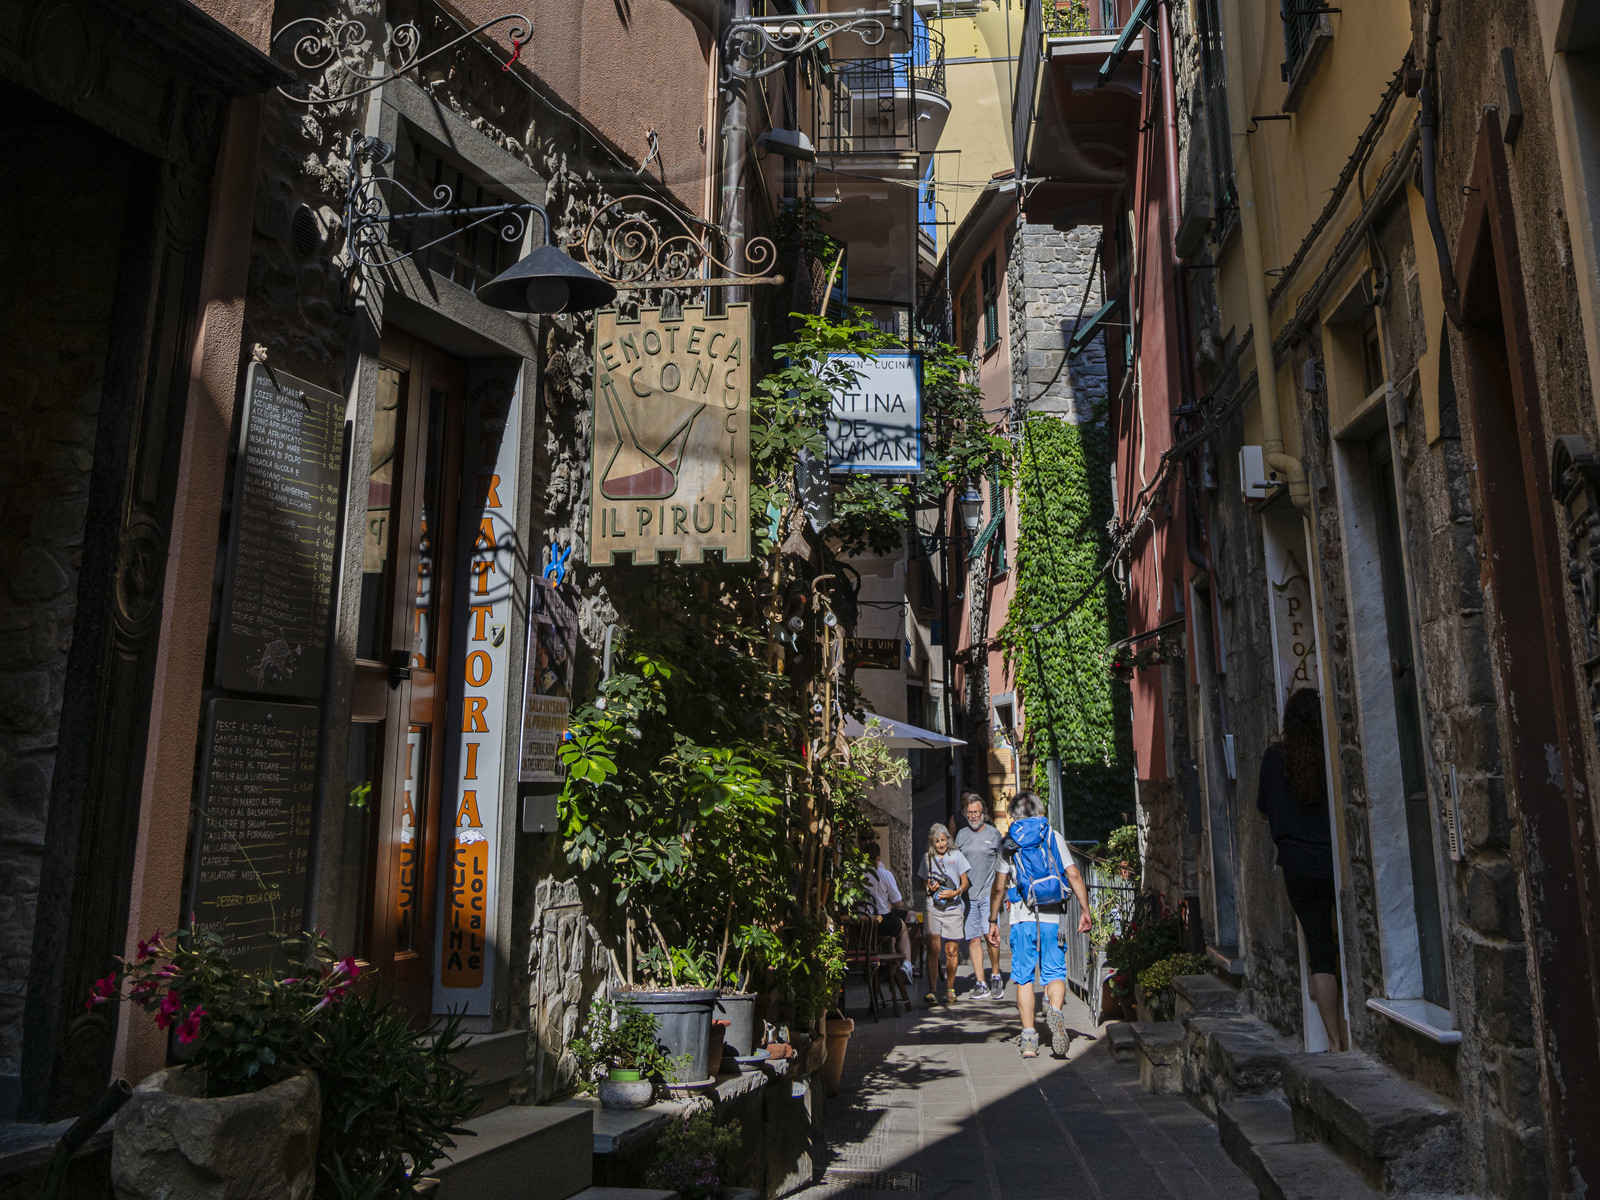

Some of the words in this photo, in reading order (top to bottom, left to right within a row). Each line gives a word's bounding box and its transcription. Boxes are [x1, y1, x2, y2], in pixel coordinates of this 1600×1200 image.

[598, 325, 742, 371] ENOTECA
[874, 360, 913, 370] CUCINA
[255, 376, 272, 386] MISTO
[629, 361, 715, 398] CON
[253, 389, 274, 401] COZZE
[276, 395, 304, 411] MARINARA
[253, 398, 280, 413] ACCIUGHE
[282, 407, 304, 420] LIMONE
[830, 393, 906, 413] NTINA
[250, 415, 268, 427] TONNO
[269, 420, 301, 436] AFFUMICATO
[251, 407, 281, 421] ACCIUGHE
[281, 414, 301, 427] SALATE
[250, 423, 266, 435] SPADA
[267, 429, 303, 445] AFFUMICATO
[721, 367, 742, 502] CUCINA
[839, 419, 868, 439] DE
[249, 434, 277, 447] INSALATA
[286, 443, 301, 454] MARE
[828, 441, 911, 462] NANAN
[247, 445, 276, 457] INSALATA
[284, 452, 302, 465] POLPO
[246, 455, 273, 468] BRESAOLA
[274, 462, 294, 474] RUCOLA
[246, 465, 281, 482] PARMIGIANO
[602, 507, 626, 538] IL
[455, 431, 504, 828] TRATTORIA
[878, 640, 894, 650] VIN
[215, 720, 238, 732] PESCE
[240, 723, 249, 732] AL
[252, 723, 277, 736] FORNO
[214, 733, 255, 745] GAMBERONI
[255, 739, 264, 748] AL
[266, 739, 287, 749] FORNO
[213, 745, 233, 756] SPADA
[234, 747, 243, 756] AL
[246, 748, 269, 759] FORNO
[212, 758, 244, 769] ACCIUGHE
[247, 761, 255, 769] AL
[256, 761, 280, 772] TEGAME
[235, 773, 249, 781] ALLA
[250, 772, 280, 783] LIVORNESE
[233, 785, 242, 794] AL
[243, 785, 263, 795] FORNO
[239, 798, 261, 806] MANZO
[260, 798, 268, 806] AL
[268, 797, 283, 806] PEPE
[236, 808, 245, 816] AL
[246, 808, 279, 817] BALSAMICO
[247, 819, 267, 829] SALUMI
[246, 830, 275, 840] FORMAGGI
[201, 856, 231, 866] CAPRESE
[200, 870, 237, 883] INSALATONE
[216, 894, 244, 908] DESSERT
[245, 893, 263, 905] DELLA
[264, 890, 281, 902] CASA
[448, 848, 467, 972] CUCINA
